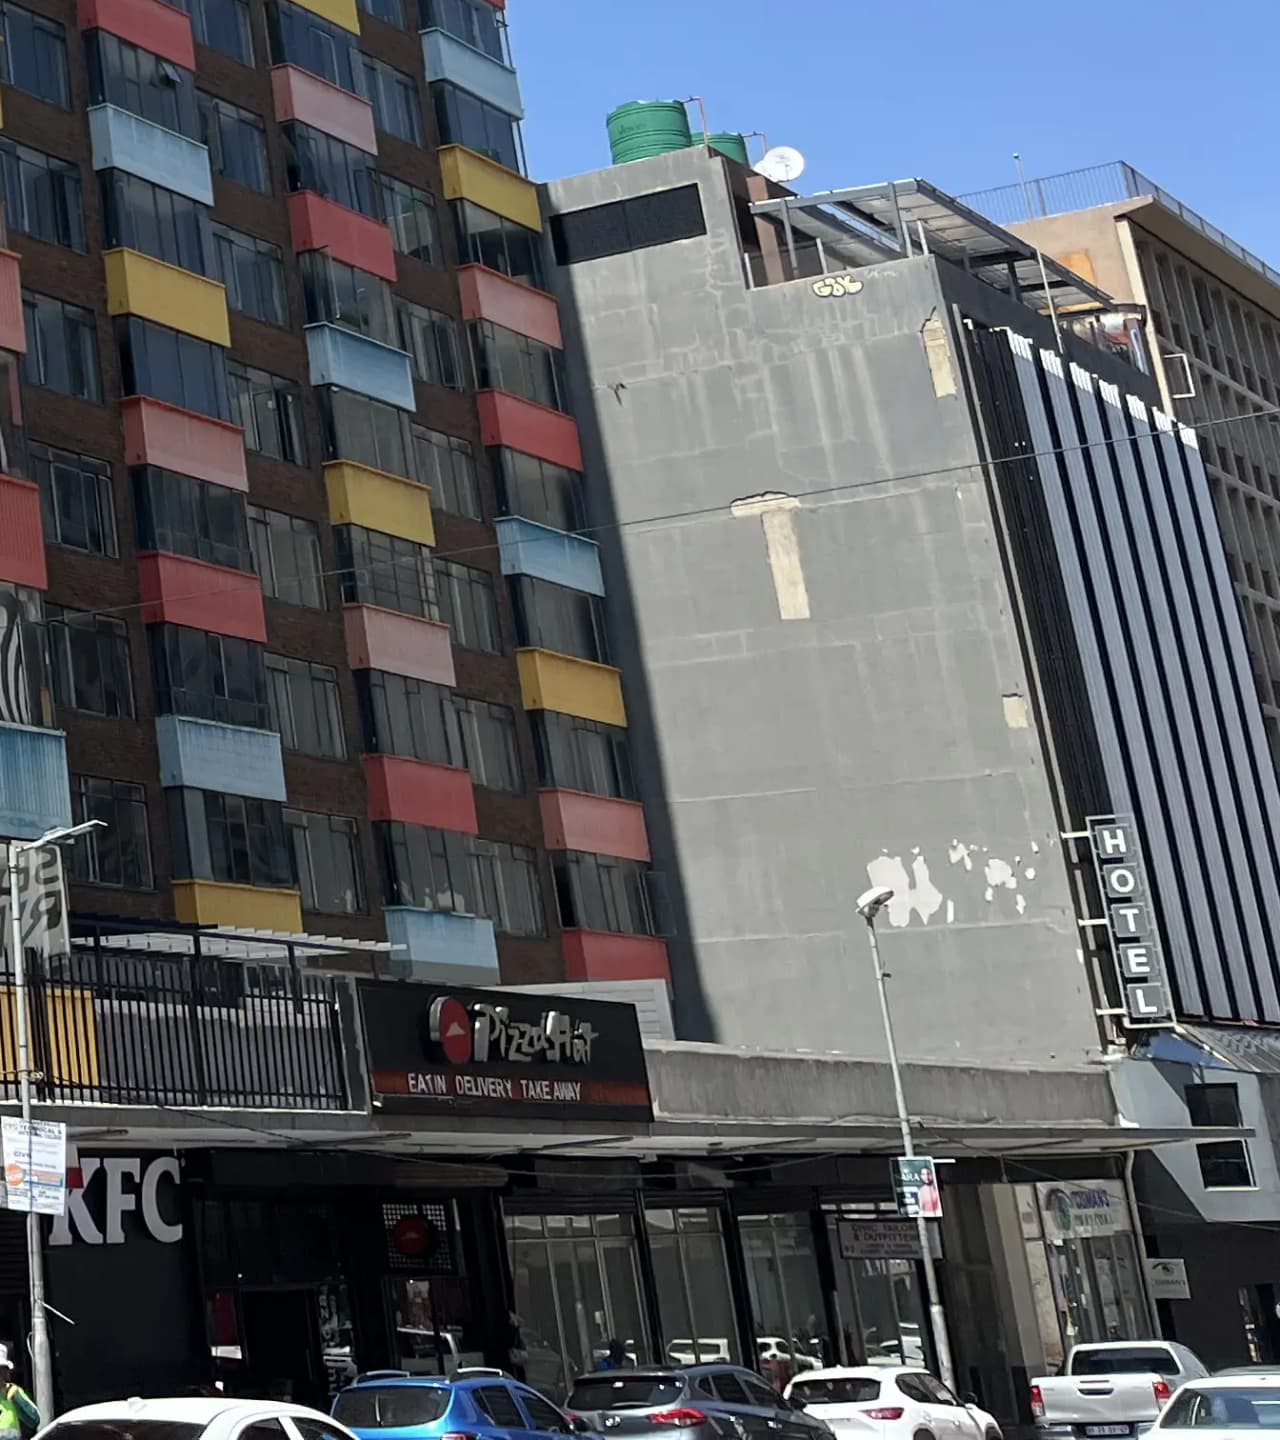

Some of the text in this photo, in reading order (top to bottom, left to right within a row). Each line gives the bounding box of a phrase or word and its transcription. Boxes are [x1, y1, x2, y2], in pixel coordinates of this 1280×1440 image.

[1102, 828, 1158, 1014] HOTEL
[473, 1003, 599, 1065] Pizza Hut
[455, 1075, 513, 1098] DELIVERY
[520, 1079, 552, 1100] TAKE
[553, 1081, 582, 1102] AWAY
[48, 1156, 183, 1246] KFC
